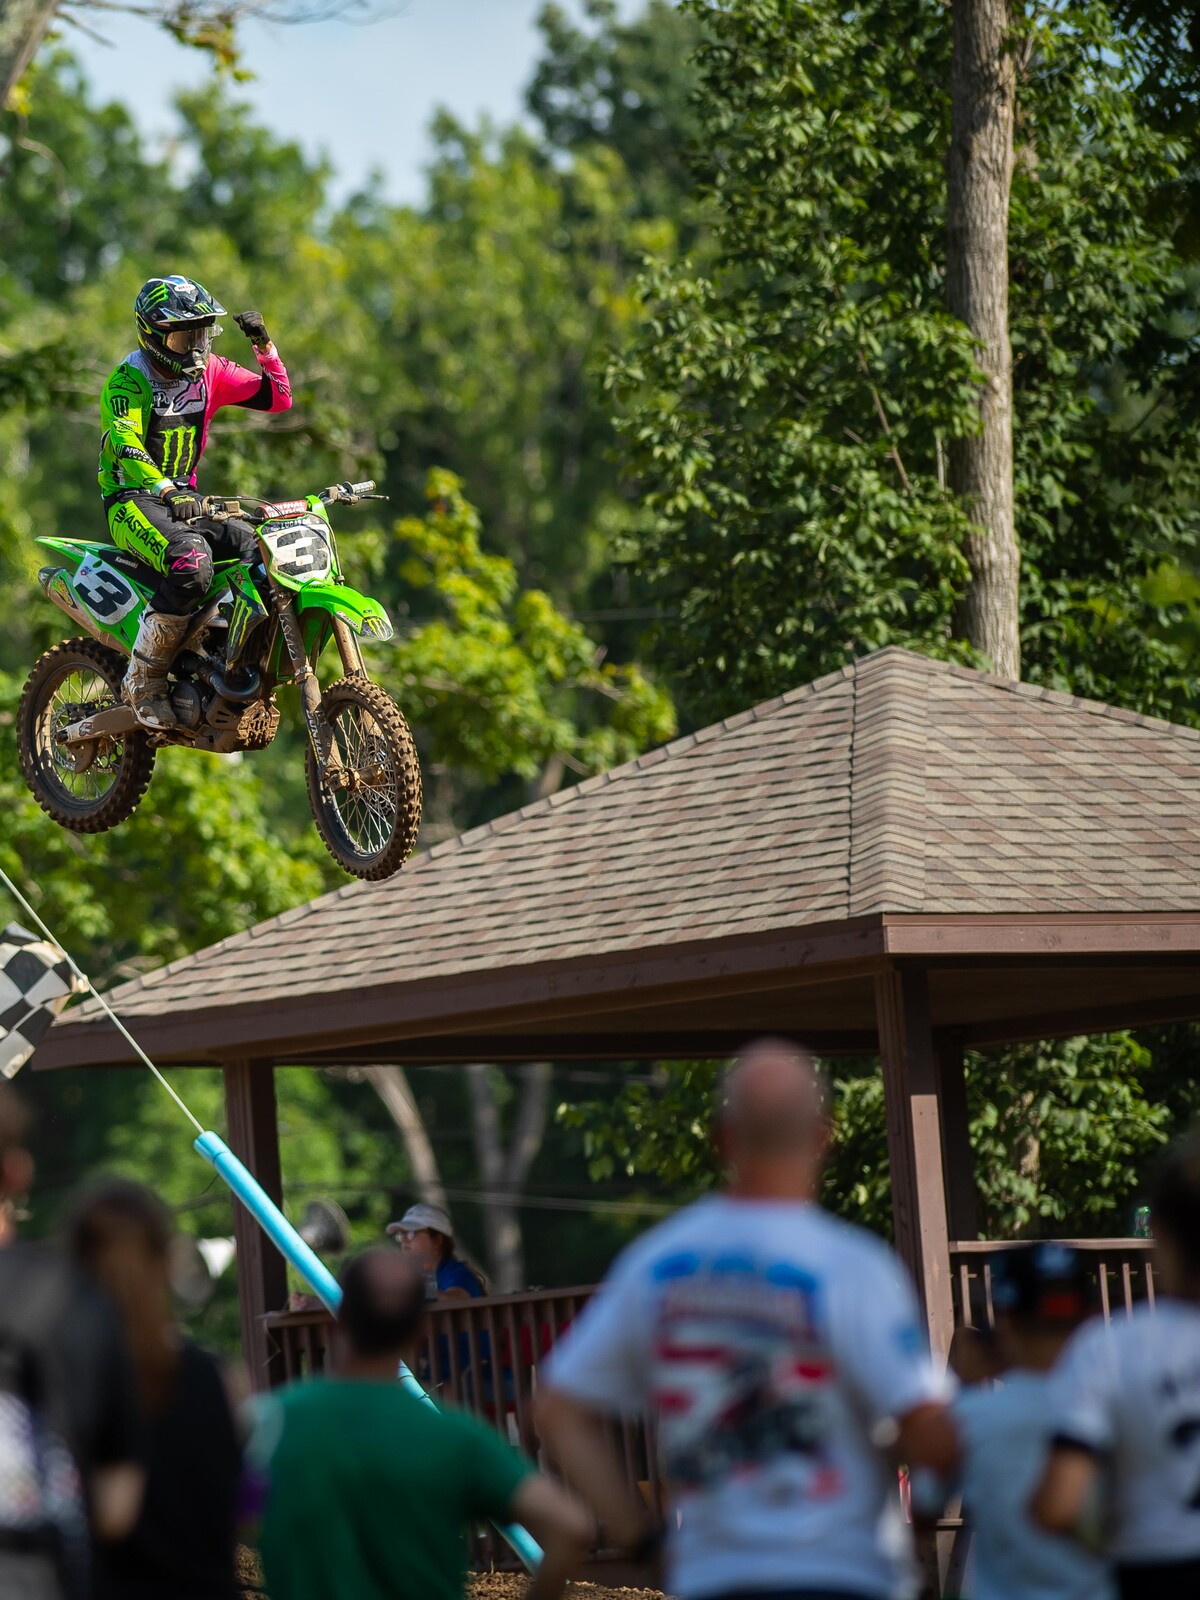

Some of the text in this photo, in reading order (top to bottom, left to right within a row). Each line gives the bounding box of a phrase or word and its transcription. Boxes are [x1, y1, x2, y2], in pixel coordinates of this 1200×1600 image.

[124, 514, 164, 556] ASTARS
[276, 529, 329, 576] 3
[74, 570, 133, 617] 3
